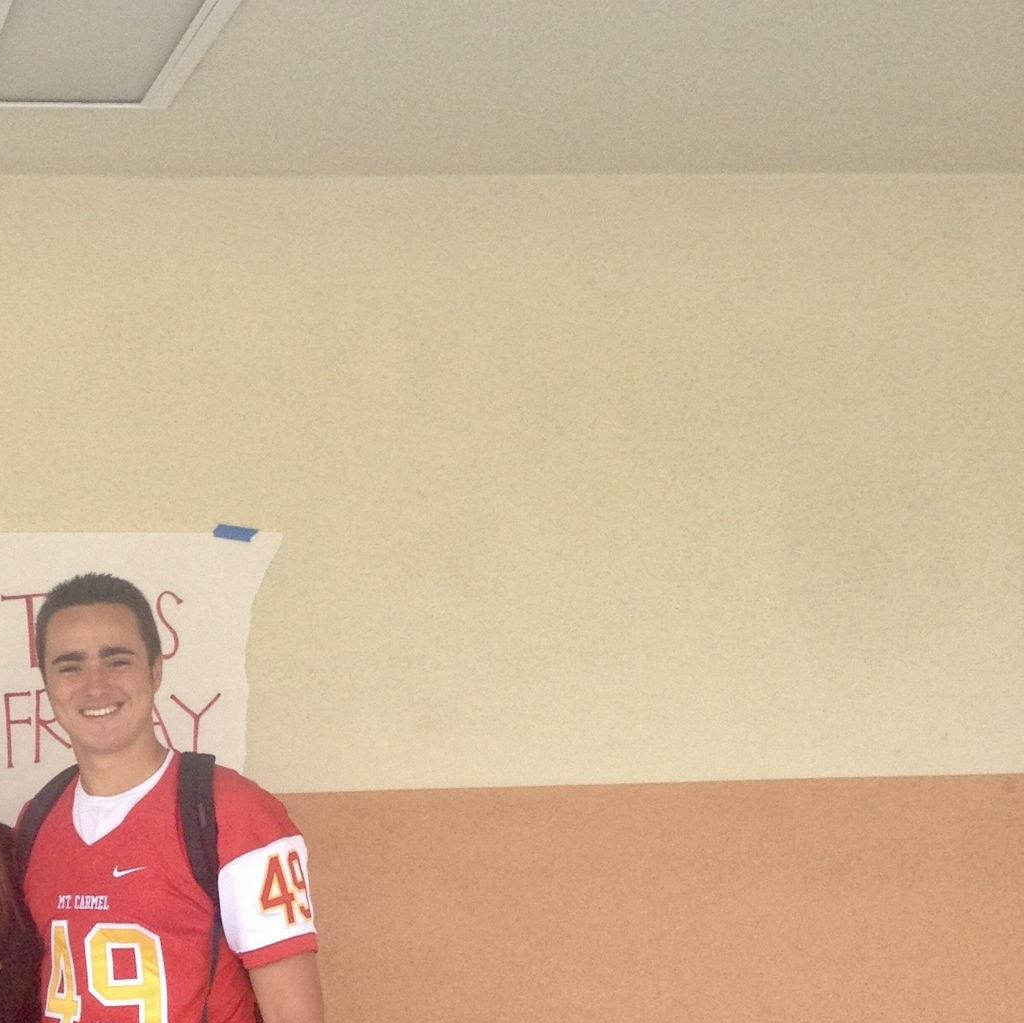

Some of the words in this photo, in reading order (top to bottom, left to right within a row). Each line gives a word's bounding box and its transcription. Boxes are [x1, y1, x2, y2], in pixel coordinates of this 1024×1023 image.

[1, 590, 184, 668] TS
[4, 690, 222, 769] FRY
[74, 894, 110, 911] CARMEL
